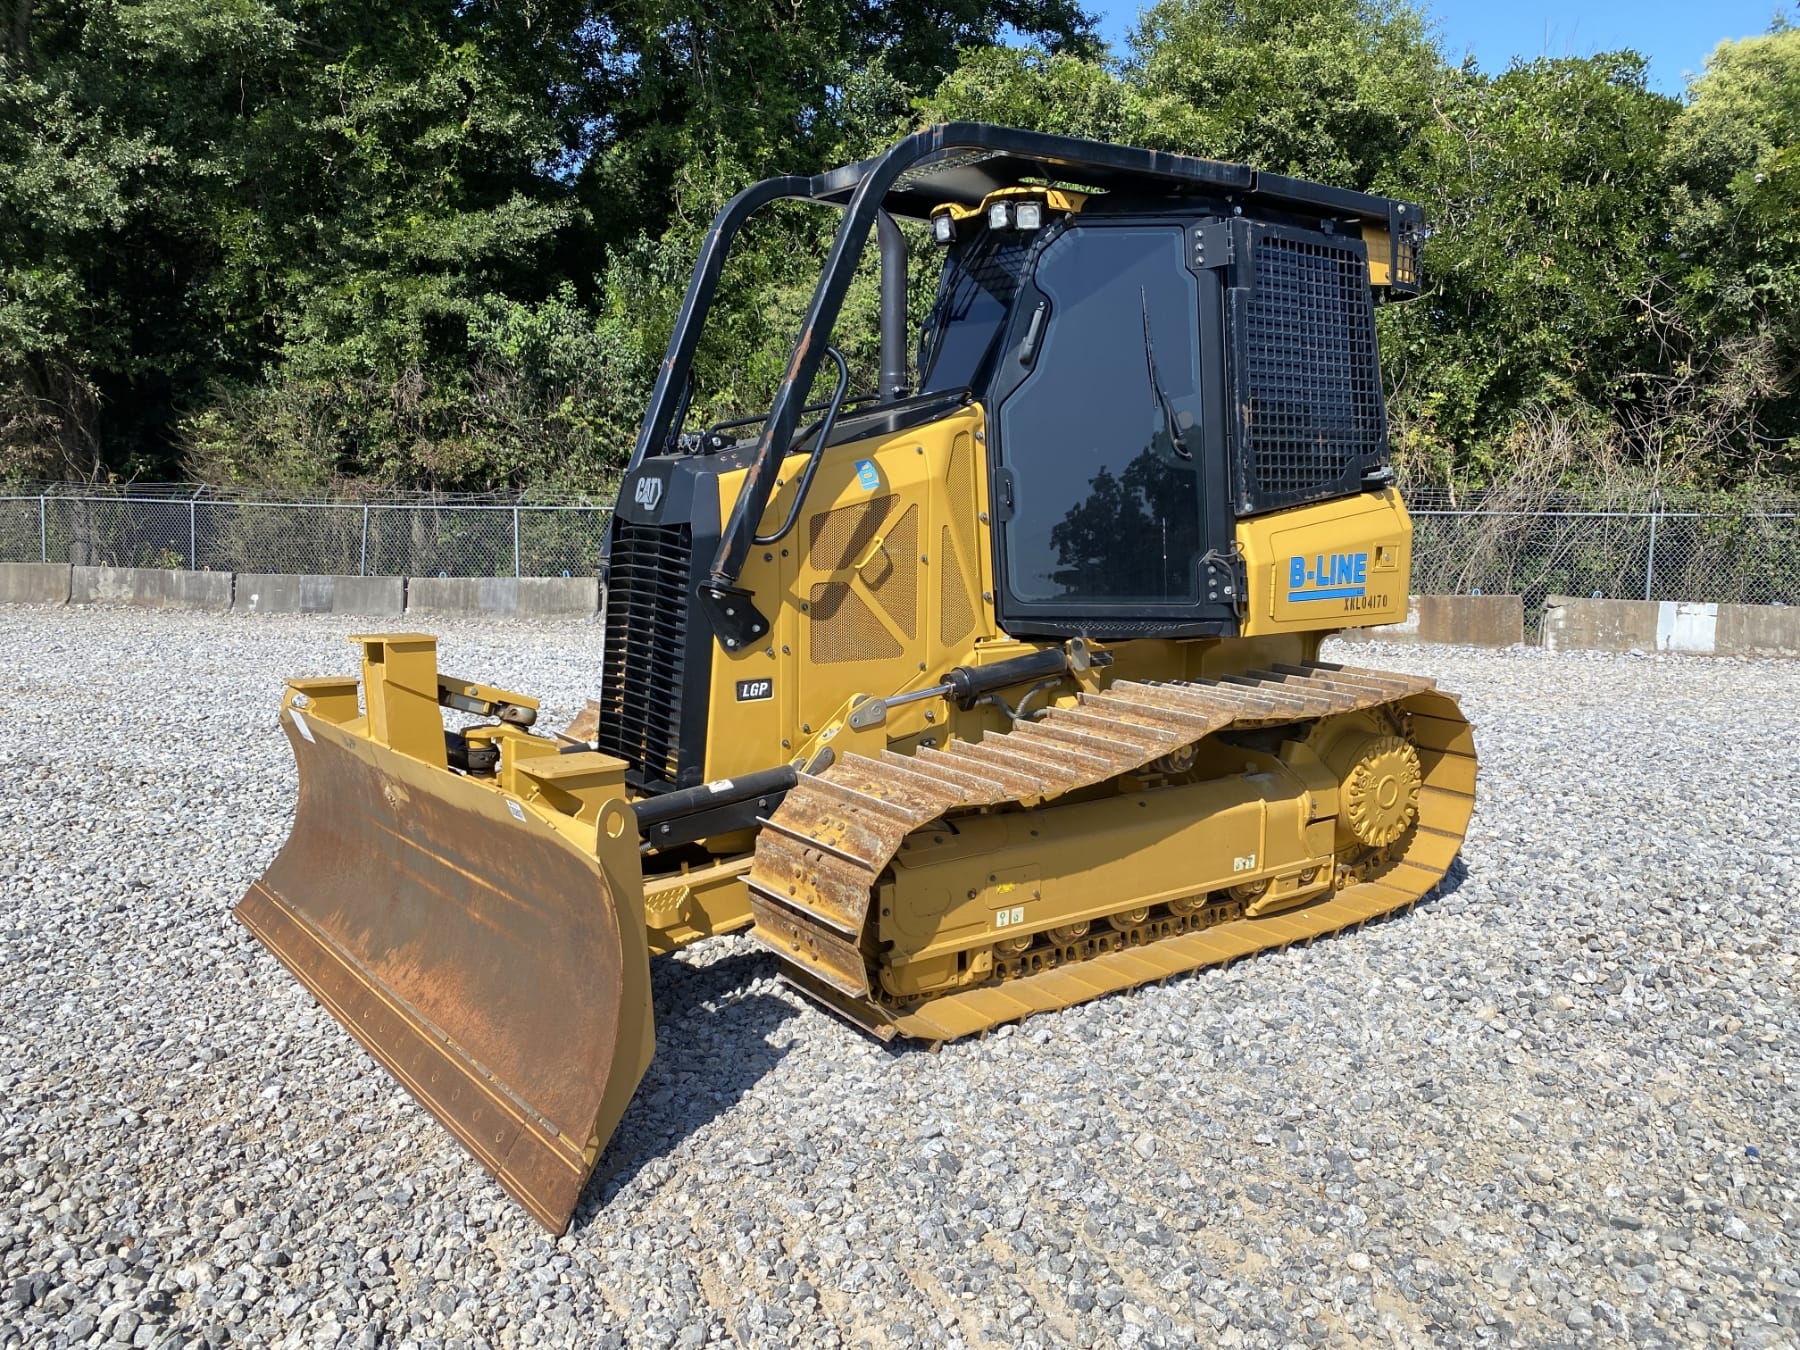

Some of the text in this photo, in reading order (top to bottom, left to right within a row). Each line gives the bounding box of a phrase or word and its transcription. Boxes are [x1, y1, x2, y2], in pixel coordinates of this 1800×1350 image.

[635, 477, 662, 510] CAT
[1289, 553, 1367, 588] B-LINE
[742, 682, 768, 697] LGP
